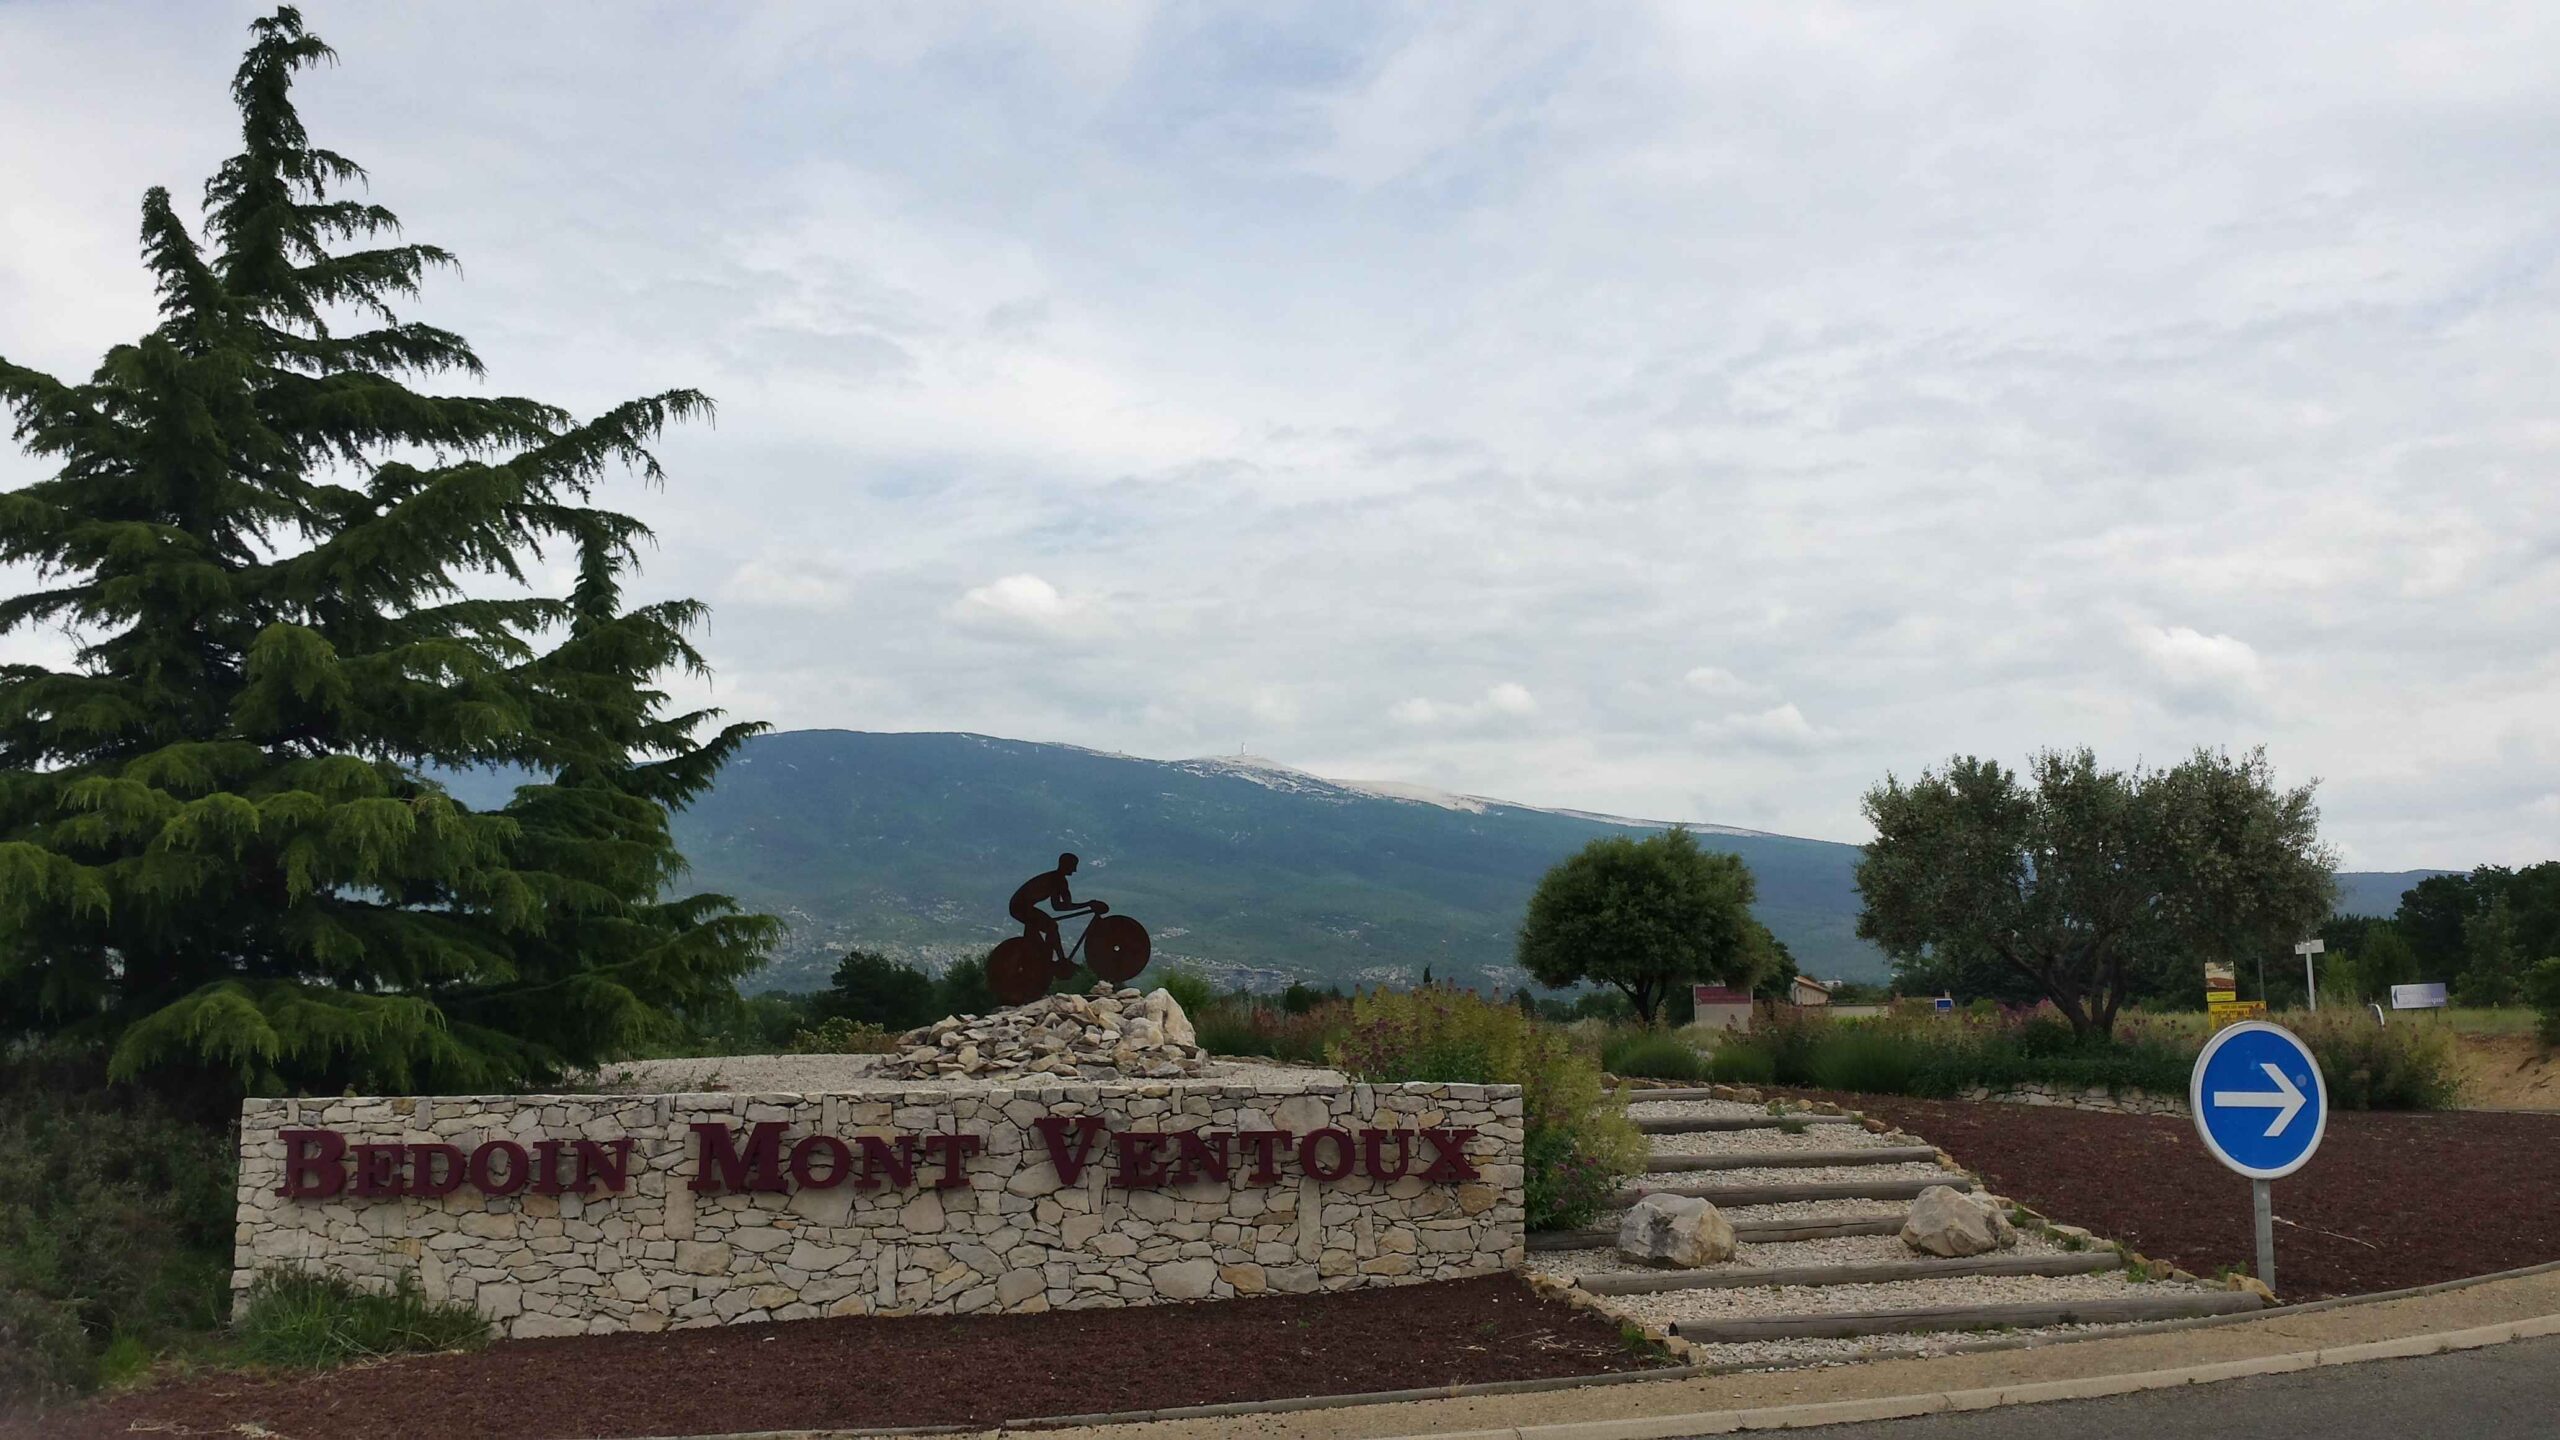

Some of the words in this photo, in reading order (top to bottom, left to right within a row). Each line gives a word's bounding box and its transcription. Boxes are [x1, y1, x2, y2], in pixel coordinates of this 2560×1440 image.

[274, 1129, 635, 1198] BEDOIN
[687, 1121, 980, 1192] MONT
[1034, 1117, 1481, 1187] VENTOUX
